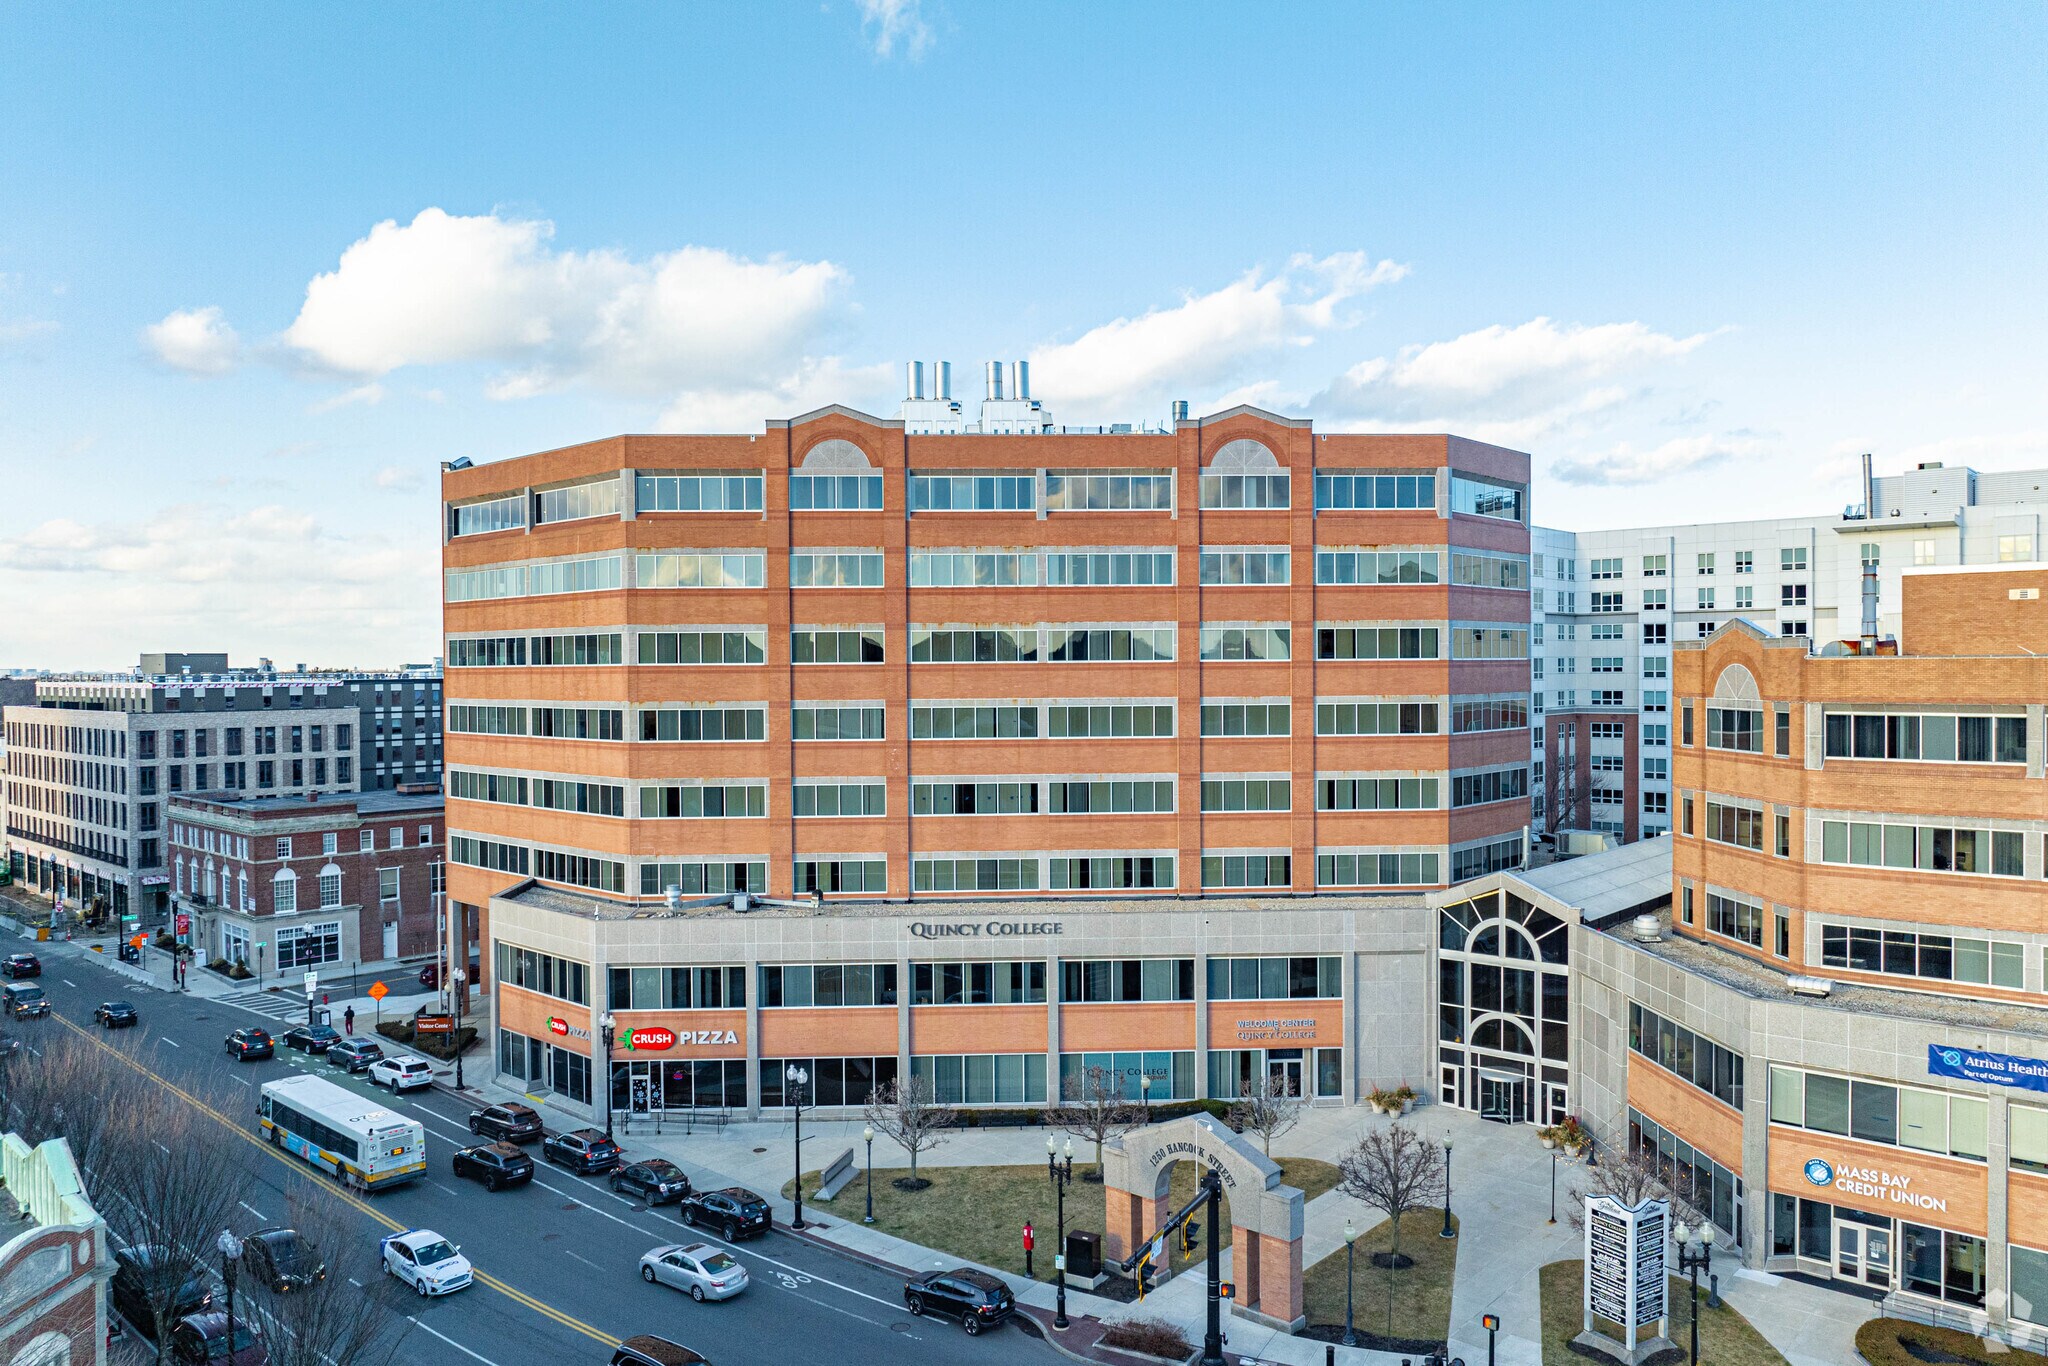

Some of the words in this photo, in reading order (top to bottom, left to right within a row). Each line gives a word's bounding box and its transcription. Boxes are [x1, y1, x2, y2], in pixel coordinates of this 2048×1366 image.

[910, 922, 981, 940] QUINCY
[986, 921, 1063, 936] COLLEGE
[1236, 1020, 1278, 1028] WELCOME
[1281, 1019, 1316, 1027] CENTER
[551, 1021, 567, 1032] CRUSH
[568, 1024, 592, 1042] PIZZA
[632, 1033, 672, 1044] CRUSH
[680, 1030, 738, 1045] PIZZA
[1236, 1031, 1274, 1041] QUINCY
[1274, 1031, 1316, 1040] COLLEGE
[1964, 1056, 2005, 1071] Atrius
[1964, 1070, 1980, 1078] Part
[1989, 1073, 2014, 1083] Optum
[1149, 1147, 1167, 1167] 1250
[1207, 1153, 1237, 1189] STREET
[1835, 1163, 1879, 1184] MASS
[1881, 1169, 1911, 1190] BAY
[1835, 1177, 1887, 1200] CREDIT
[1889, 1189, 1948, 1213] UNION
[436, 1260, 459, 1270] GEICO
